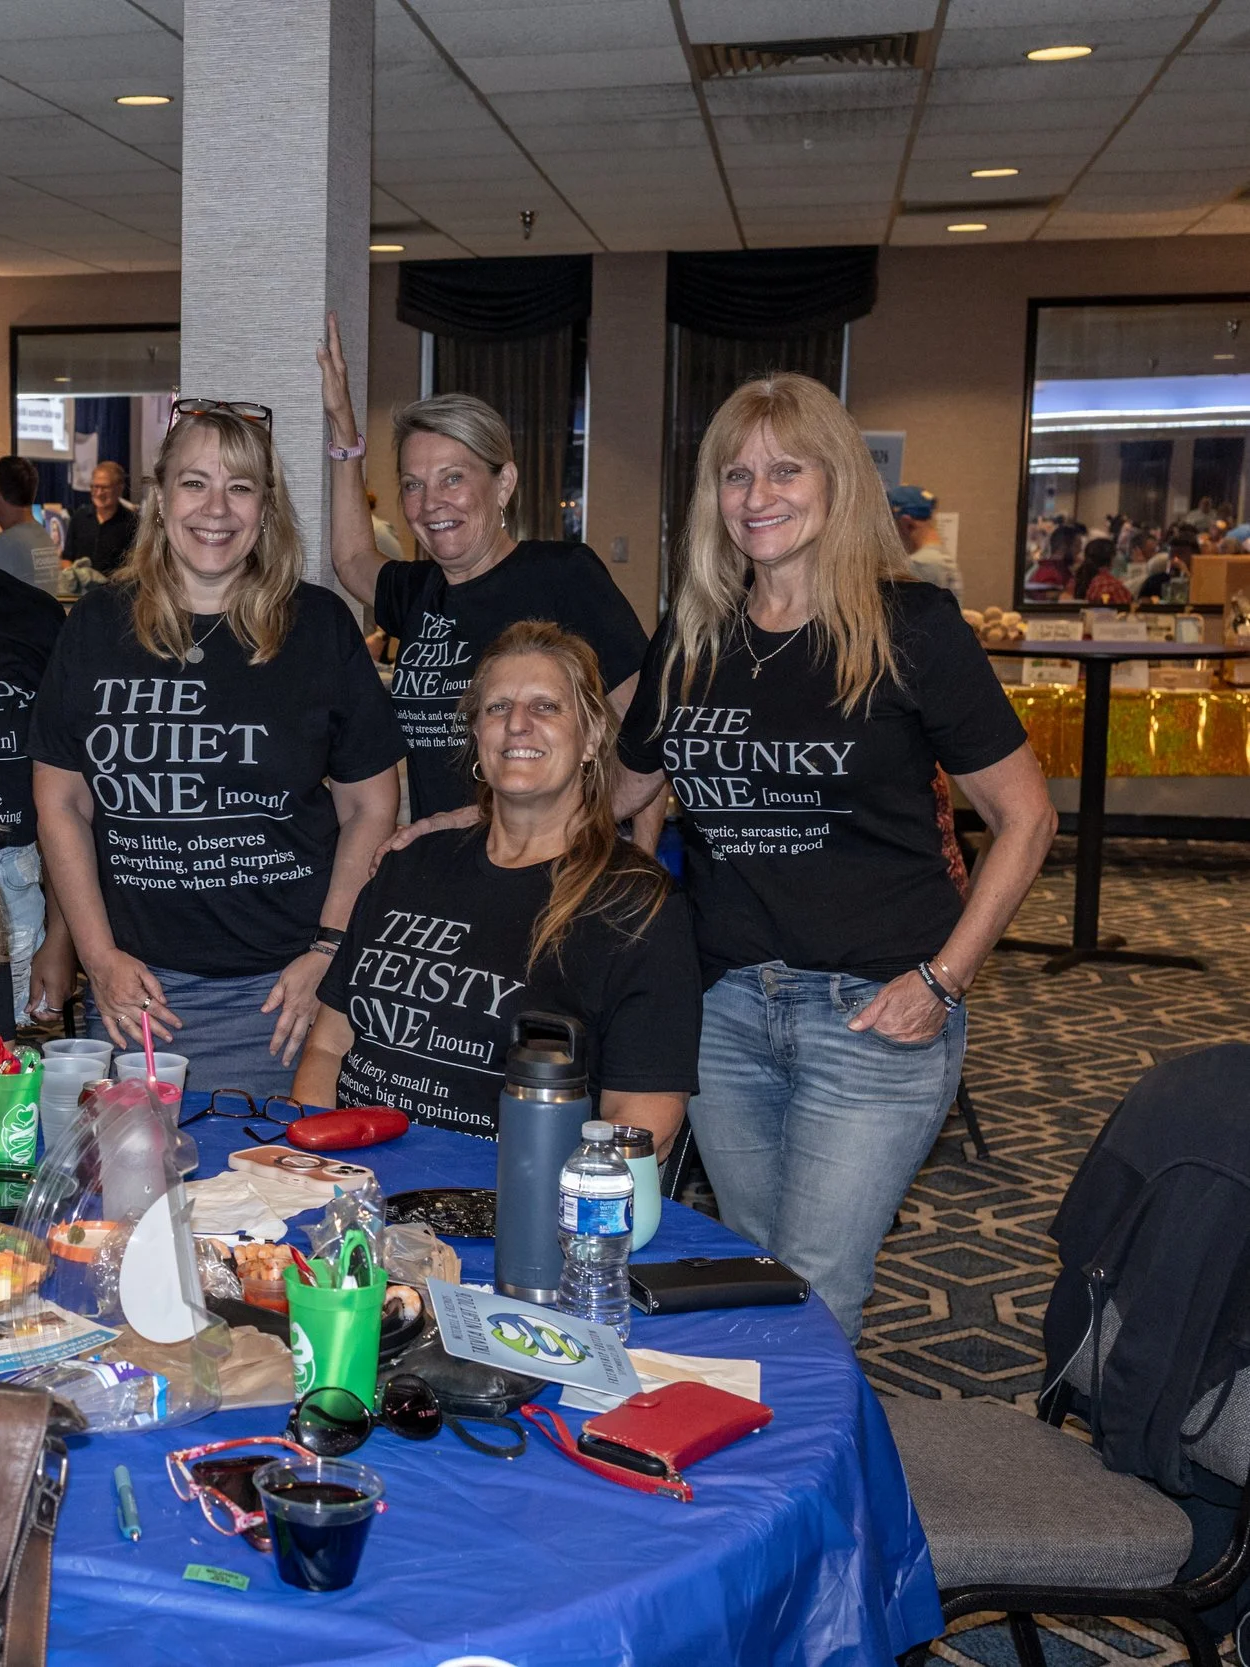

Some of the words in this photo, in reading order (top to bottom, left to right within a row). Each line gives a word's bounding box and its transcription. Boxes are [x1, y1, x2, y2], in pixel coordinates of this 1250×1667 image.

[400, 641, 472, 667] CHILL
[390, 668, 441, 696] ONE
[442, 679, 472, 694] [nou
[93, 678, 206, 715] THE
[394, 709, 426, 720] aid-back
[428, 710, 442, 720] and
[668, 706, 751, 735] THE
[85, 723, 269, 774] QUIET
[415, 737, 431, 747] with
[433, 737, 446, 747] the
[663, 738, 855, 775] SPUNKY
[92, 773, 208, 813] ONE
[218, 786, 290, 811] [noun]
[672, 777, 755, 807] ONE
[762, 788, 821, 806] [noun]
[108, 829, 138, 850] Says
[141, 835, 182, 853] little,
[187, 833, 265, 850] observes
[741, 825, 801, 838] sarcastic,
[805, 823, 830, 837] and
[721, 841, 756, 855] ready
[759, 841, 776, 853] for
[779, 844, 787, 853] a
[791, 839, 823, 854] good
[110, 853, 188, 874] everything,
[193, 854, 226, 871] and
[230, 849, 295, 869] surprises
[113, 873, 176, 890] everyone
[180, 877, 226, 890] when
[230, 871, 258, 886] she
[374, 909, 471, 955] THE
[349, 947, 526, 1019] FEISTY
[350, 995, 430, 1048] ONE
[427, 1026, 494, 1064] [noun]
[347, 1049, 363, 1070] old,
[361, 1061, 387, 1083] fiery,
[390, 1072, 429, 1094] small
[433, 1081, 449, 1098] in
[338, 1070, 372, 1099] patience,
[376, 1086, 396, 1108] big
[399, 1093, 412, 1111] in
[417, 1103, 495, 1129] opinions,
[460, 1308, 483, 1331] NIGHT
[467, 1331, 490, 1355] TRIVIA
